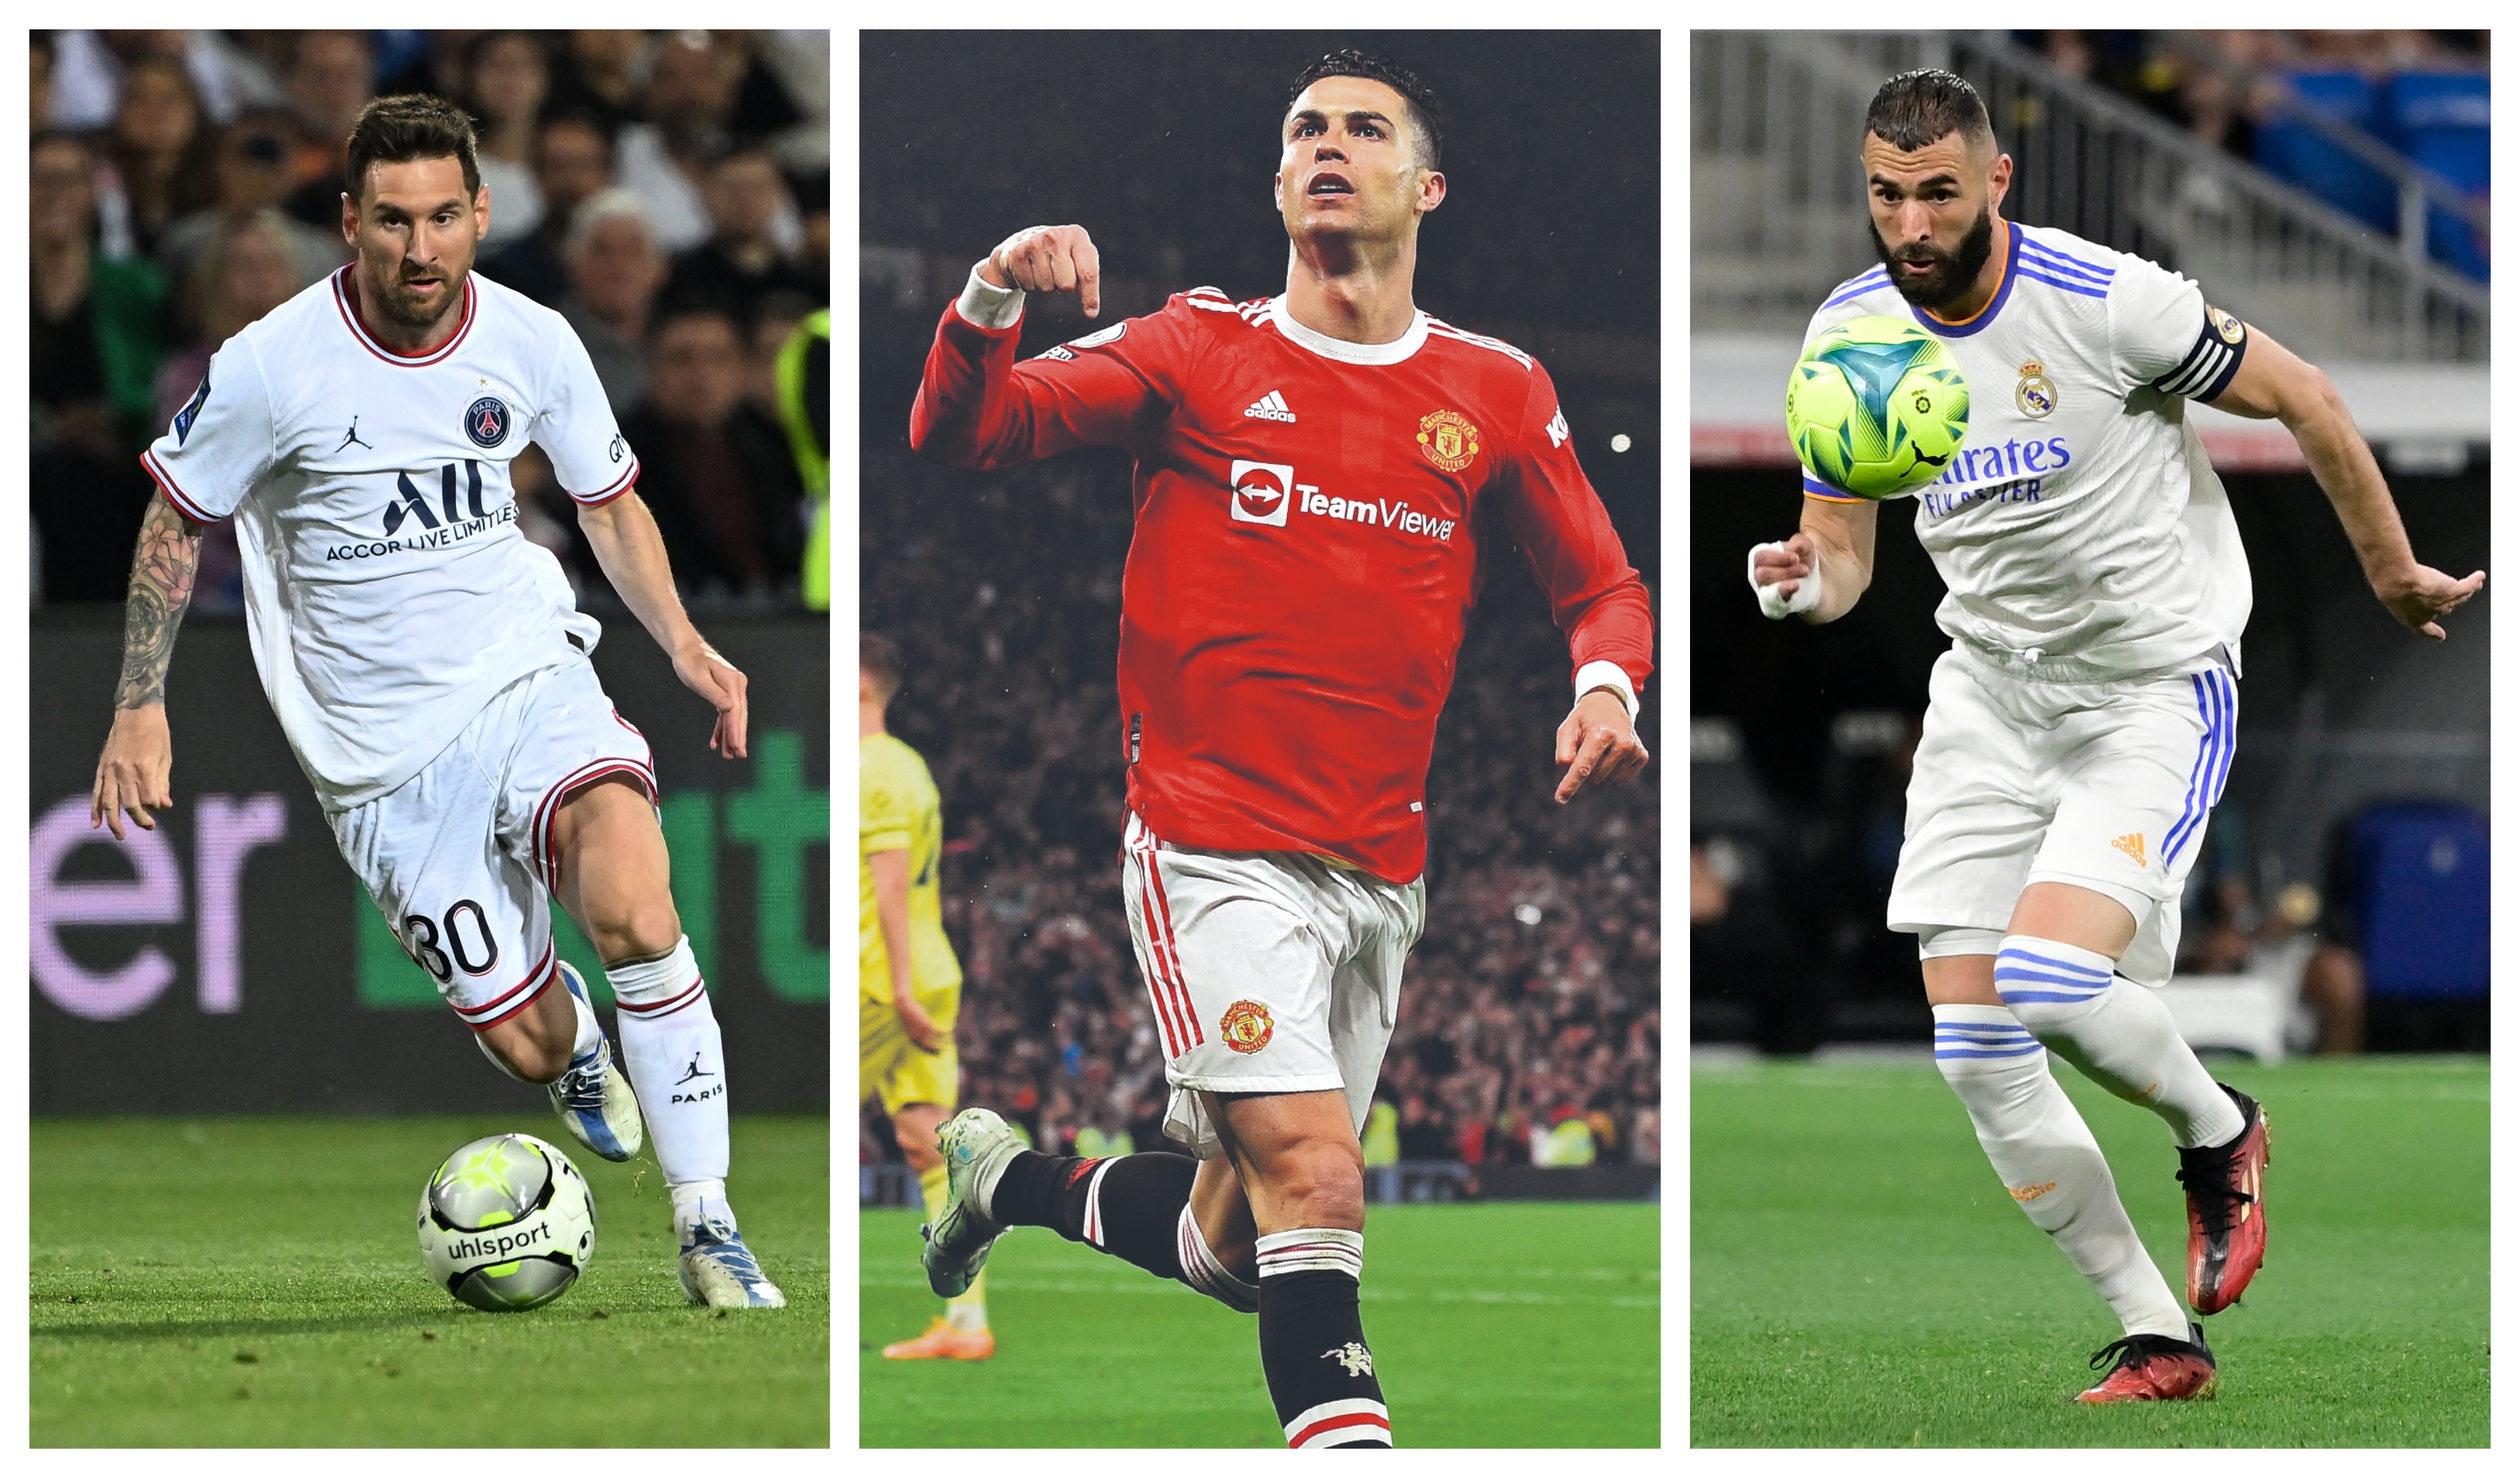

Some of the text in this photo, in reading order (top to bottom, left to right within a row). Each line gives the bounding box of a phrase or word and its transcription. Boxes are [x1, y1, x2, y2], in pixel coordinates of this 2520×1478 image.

[472, 401, 502, 415] PARIS
[1243, 407, 1296, 424] adidas
[1424, 414, 1474, 438] MANCHESTER
[1431, 453, 1465, 468] UNITED
[1932, 436, 2071, 485] irates
[1296, 483, 1455, 541] TeamViewer
[327, 540, 402, 561] ACCOR
[408, 528, 450, 550] LIVE
[2111, 839, 2147, 868] adidas
[405, 898, 500, 984] 30
[1224, 1003, 1265, 1028] MANCHESTER
[1238, 1036, 1268, 1050] UNITED
[671, 1083, 723, 1104] PARIS
[448, 1221, 551, 1260] uhlsport
